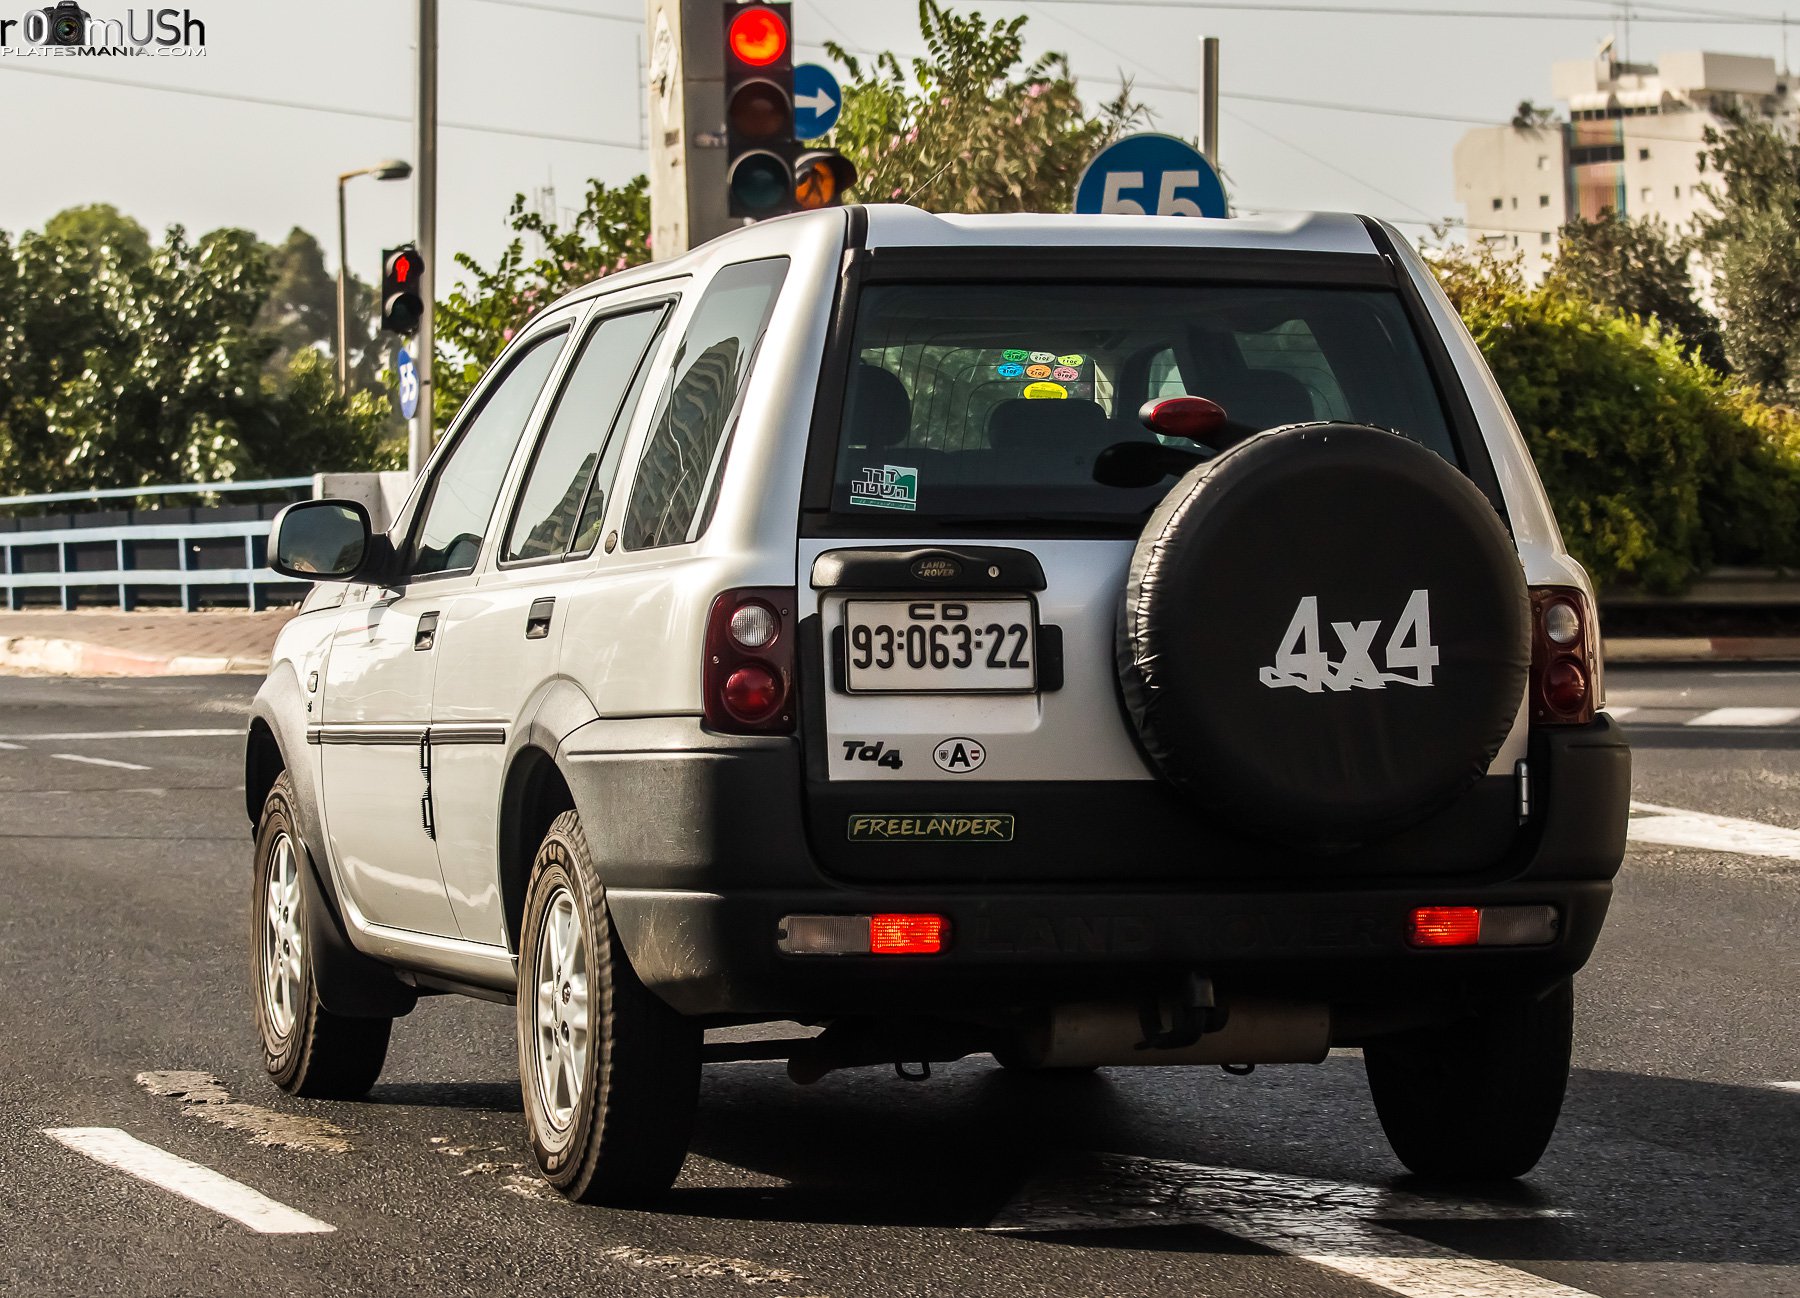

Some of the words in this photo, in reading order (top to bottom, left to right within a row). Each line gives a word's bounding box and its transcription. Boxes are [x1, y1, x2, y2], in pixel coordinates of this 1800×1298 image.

[399, 361, 417, 404] 55
[862, 467, 896, 485] דרך
[851, 480, 908, 499] השטח
[908, 603, 969, 621] CD
[1259, 589, 1440, 693] 4x4
[842, 740, 904, 770] Td4
[948, 742, 972, 768] A
[853, 818, 1004, 838] FREELANDER
